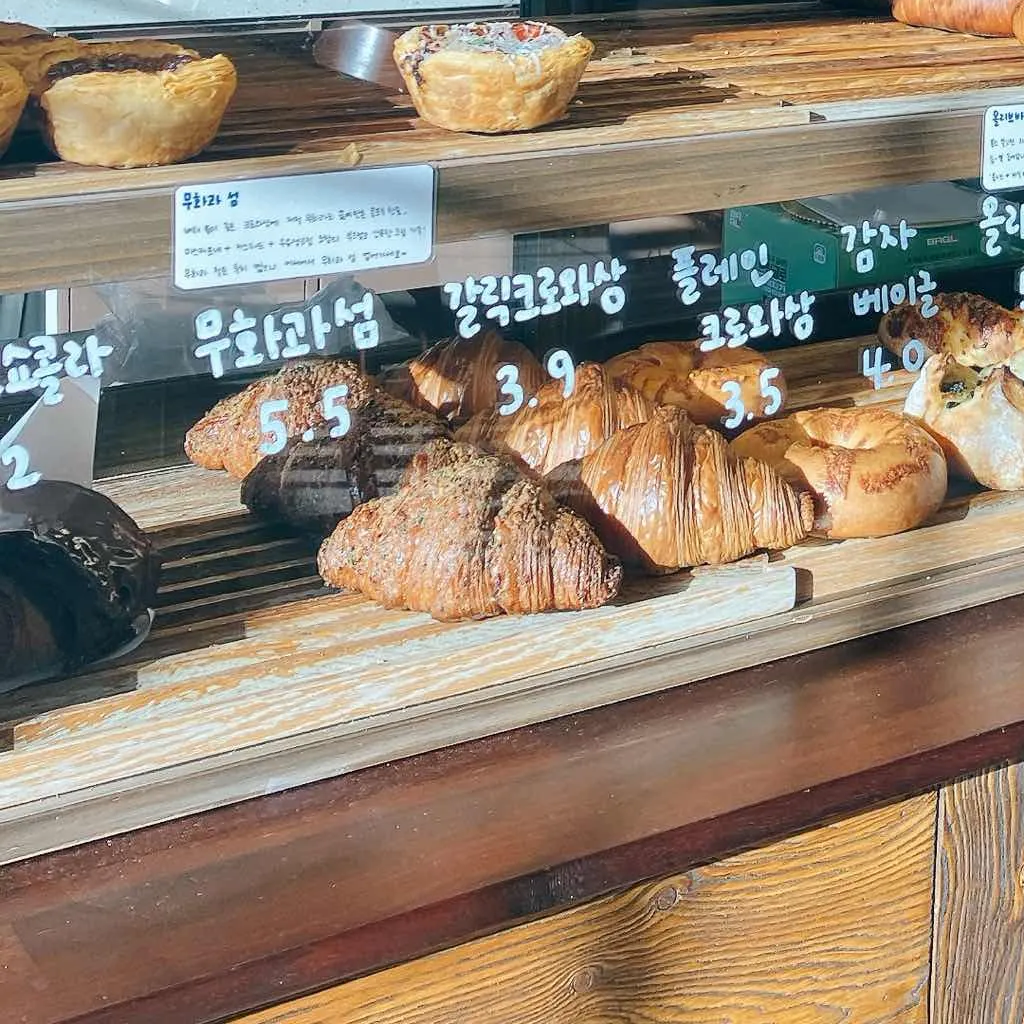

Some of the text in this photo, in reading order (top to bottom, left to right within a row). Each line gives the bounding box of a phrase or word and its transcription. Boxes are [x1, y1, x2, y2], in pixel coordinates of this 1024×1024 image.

[183, 191, 239, 210] 무화과 섬
[672, 243, 774, 306] 플레인
[841, 219, 918, 274] 감자
[443, 258, 628, 339] 갈릭크로와상
[700, 290, 816, 353] 크로와상
[853, 270, 940, 319] 베이글
[194, 291, 380, 378] 무화과섬
[863, 339, 925, 391] 4.0
[0, 335, 114, 406] 쇼콜라
[496, 350, 575, 416] 3.9
[721, 367, 782, 429] 3.5
[258, 384, 352, 456] 5.5
